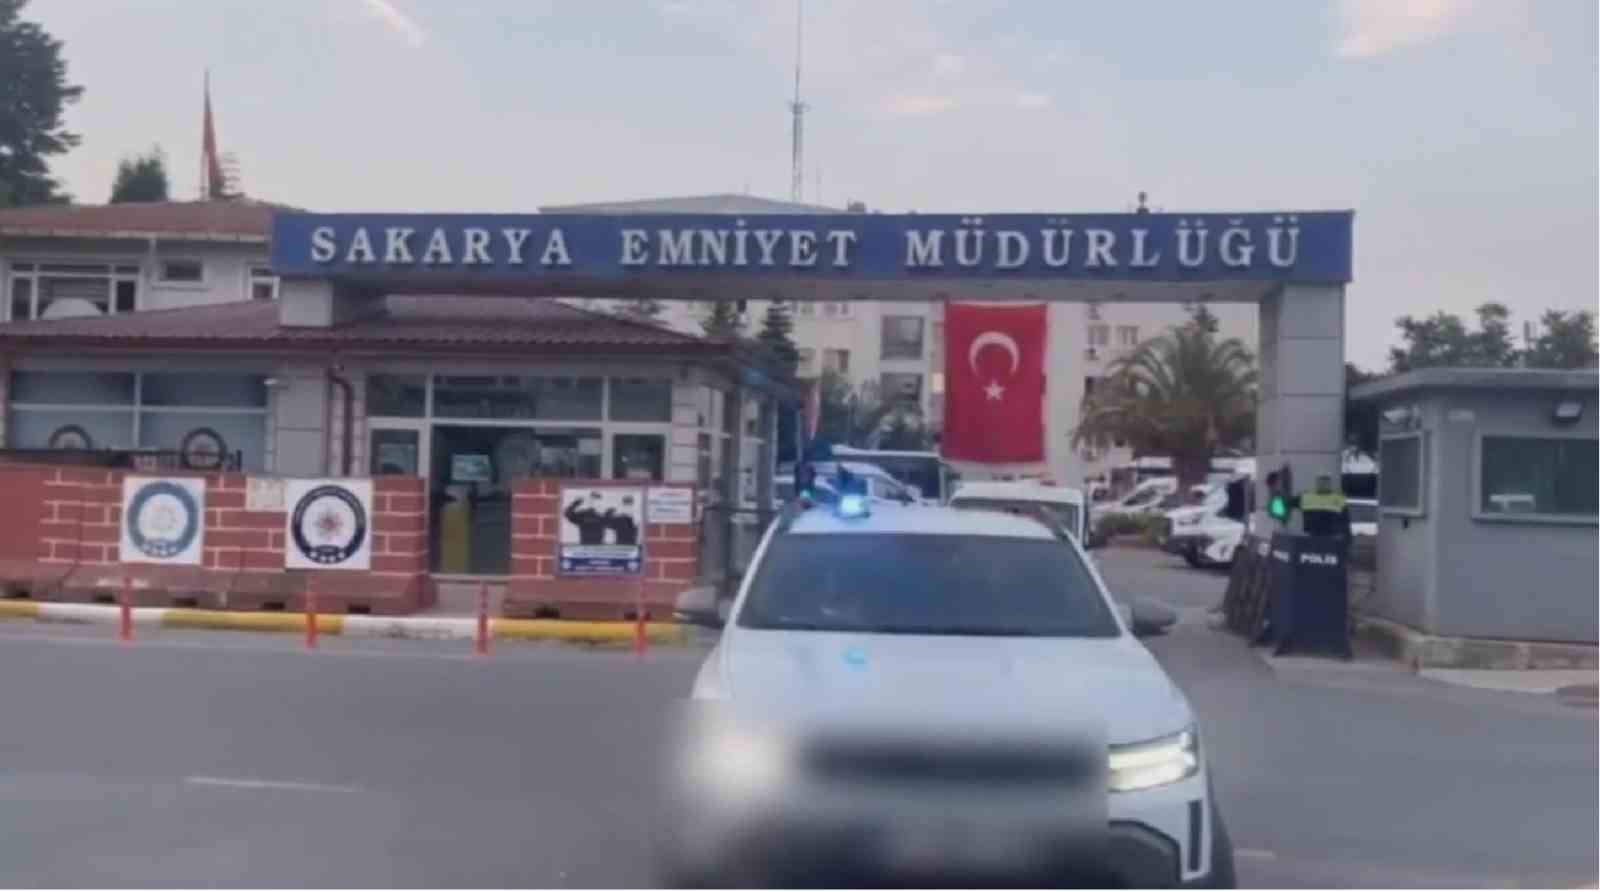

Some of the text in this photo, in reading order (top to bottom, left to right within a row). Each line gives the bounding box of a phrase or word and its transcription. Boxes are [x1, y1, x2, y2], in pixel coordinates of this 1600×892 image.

[311, 216, 1300, 267] SAKARYA EMNİYET MÜDÜRLÜĞÜ
